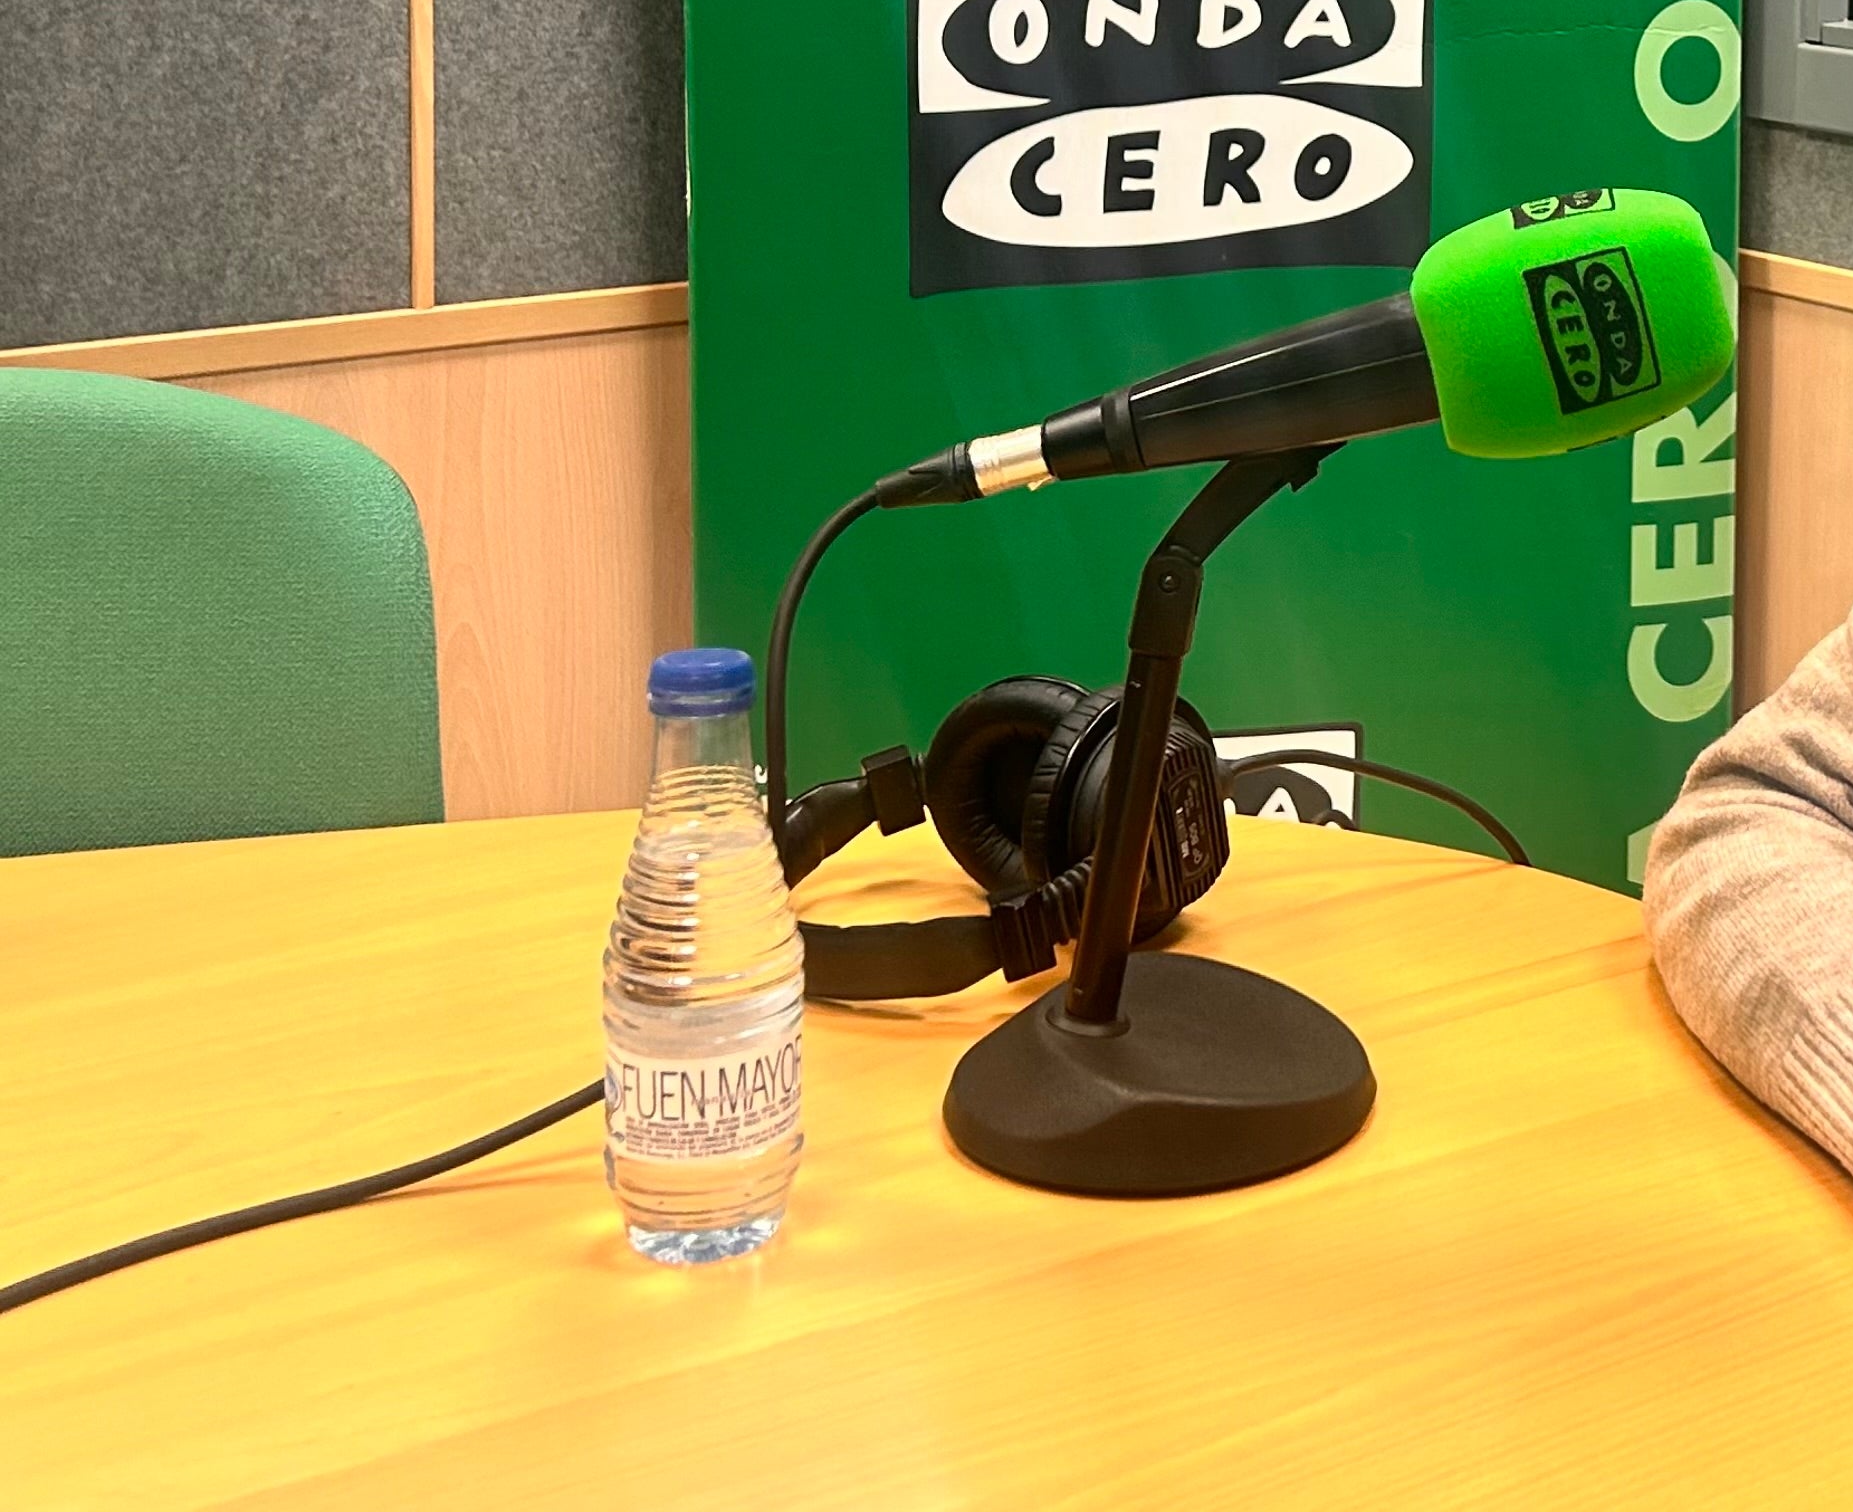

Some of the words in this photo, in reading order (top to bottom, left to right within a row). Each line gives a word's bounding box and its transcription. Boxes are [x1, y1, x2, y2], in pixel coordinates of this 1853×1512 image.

[1009, 127, 1353, 217] CERO
[1550, 290, 1597, 388] CERO
[1593, 273, 1634, 376] ONDA
[1627, 251, 1738, 722] CER
[622, 1063, 706, 1122] FUEN
